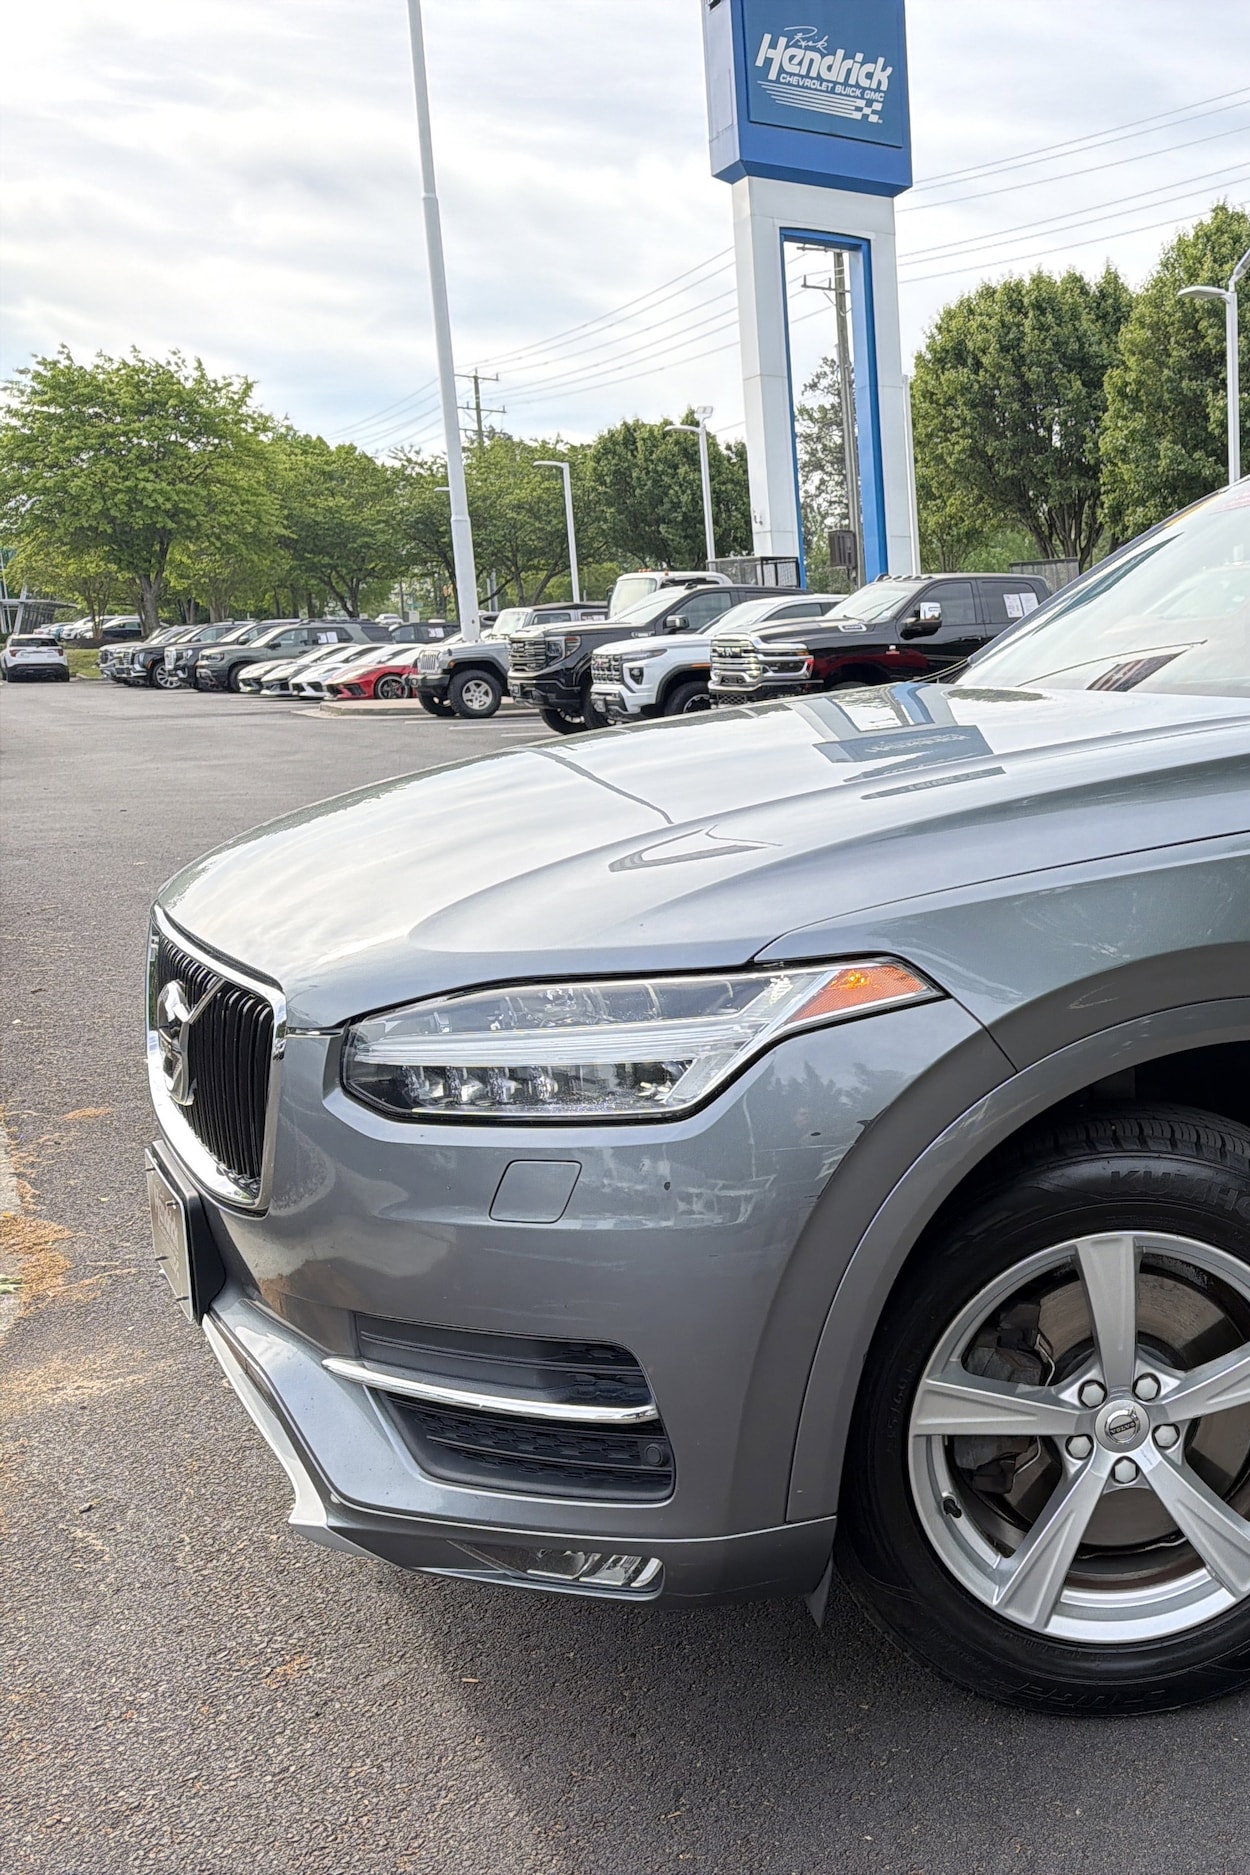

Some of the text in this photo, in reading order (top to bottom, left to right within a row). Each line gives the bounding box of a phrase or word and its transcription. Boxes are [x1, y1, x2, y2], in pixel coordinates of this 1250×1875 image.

[754, 33, 893, 91] Hendrick
[779, 73, 885, 101] CHEVROLET BUICK GMC
[1111, 1422, 1136, 1434] VOLVO
